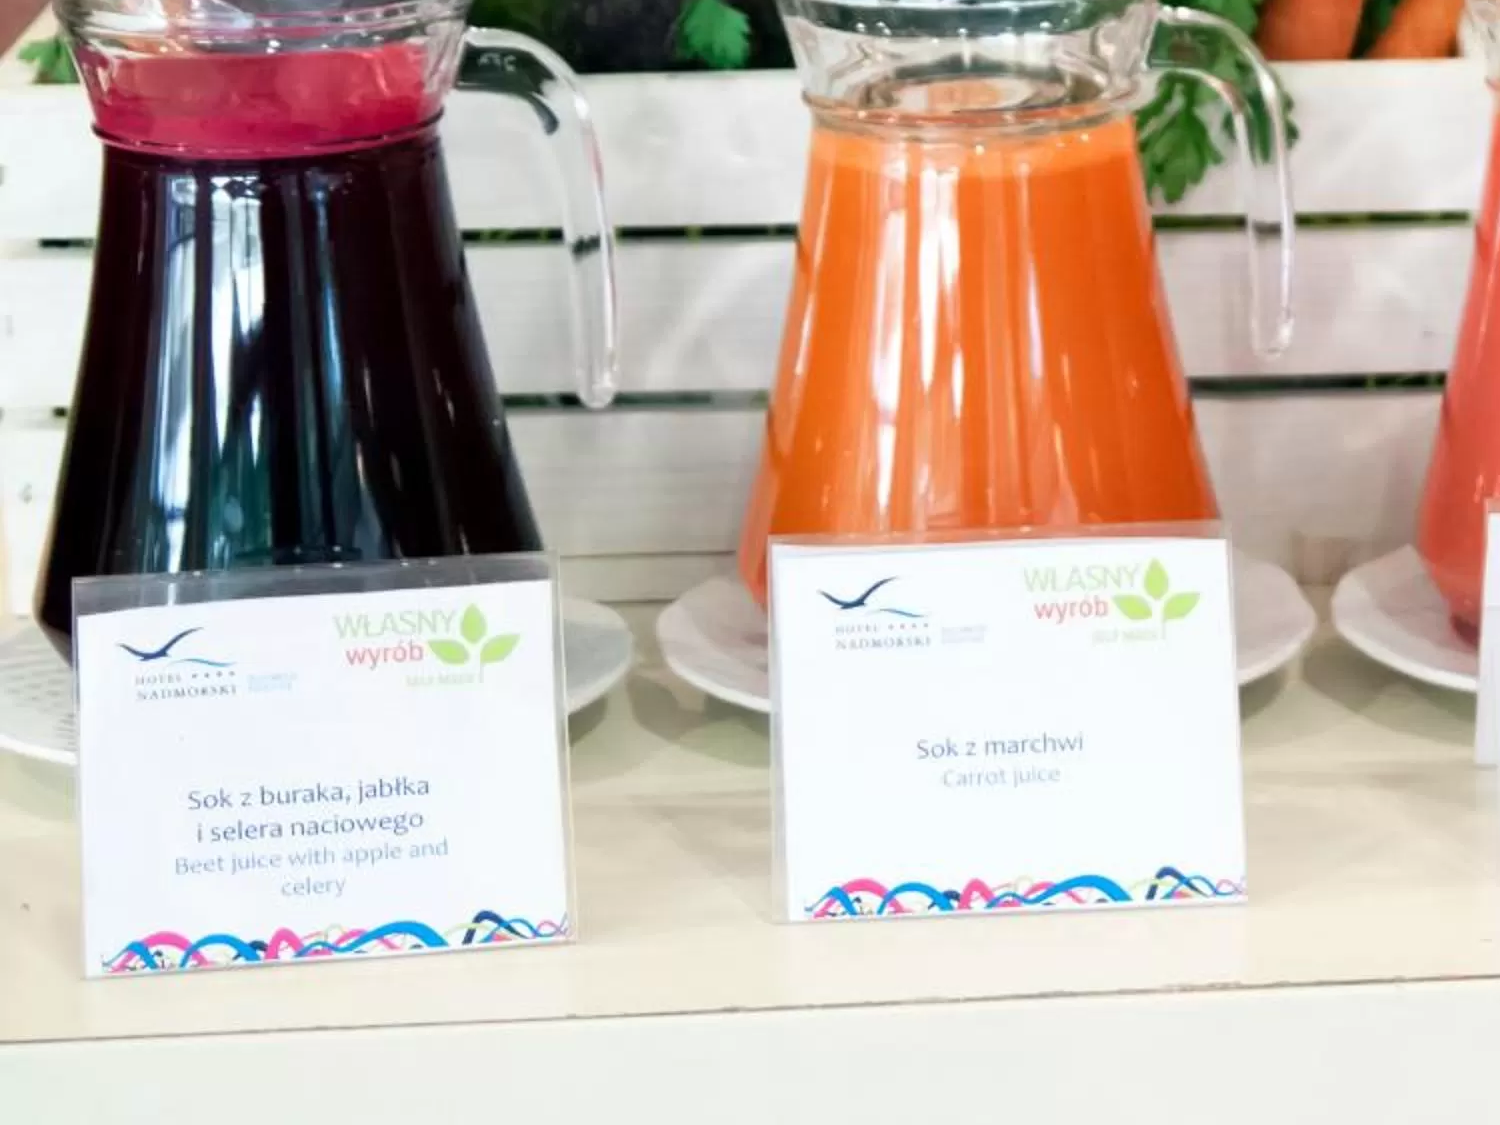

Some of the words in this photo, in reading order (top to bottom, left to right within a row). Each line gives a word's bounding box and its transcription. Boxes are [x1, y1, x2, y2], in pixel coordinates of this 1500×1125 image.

[332, 609, 457, 639] WŁASNY
[1033, 593, 1109, 625] wyrób
[345, 639, 424, 671] wyrób
[916, 738, 959, 760] Sok
[965, 740, 977, 757] z
[984, 730, 1084, 757] marchwi
[943, 767, 1007, 788] Carrot
[1013, 765, 1061, 789] juice
[187, 788, 233, 810] Sok
[241, 792, 252, 808] z
[260, 783, 351, 806] buraka,
[358, 776, 430, 805] jabłka
[197, 822, 203, 843] i
[210, 820, 283, 843] selera
[290, 812, 424, 837] naciowego
[175, 856, 224, 876] Beet
[231, 851, 282, 876] juice
[288, 846, 335, 867] with
[341, 841, 401, 866] apple
[408, 837, 449, 858] and
[280, 877, 347, 897] celery
